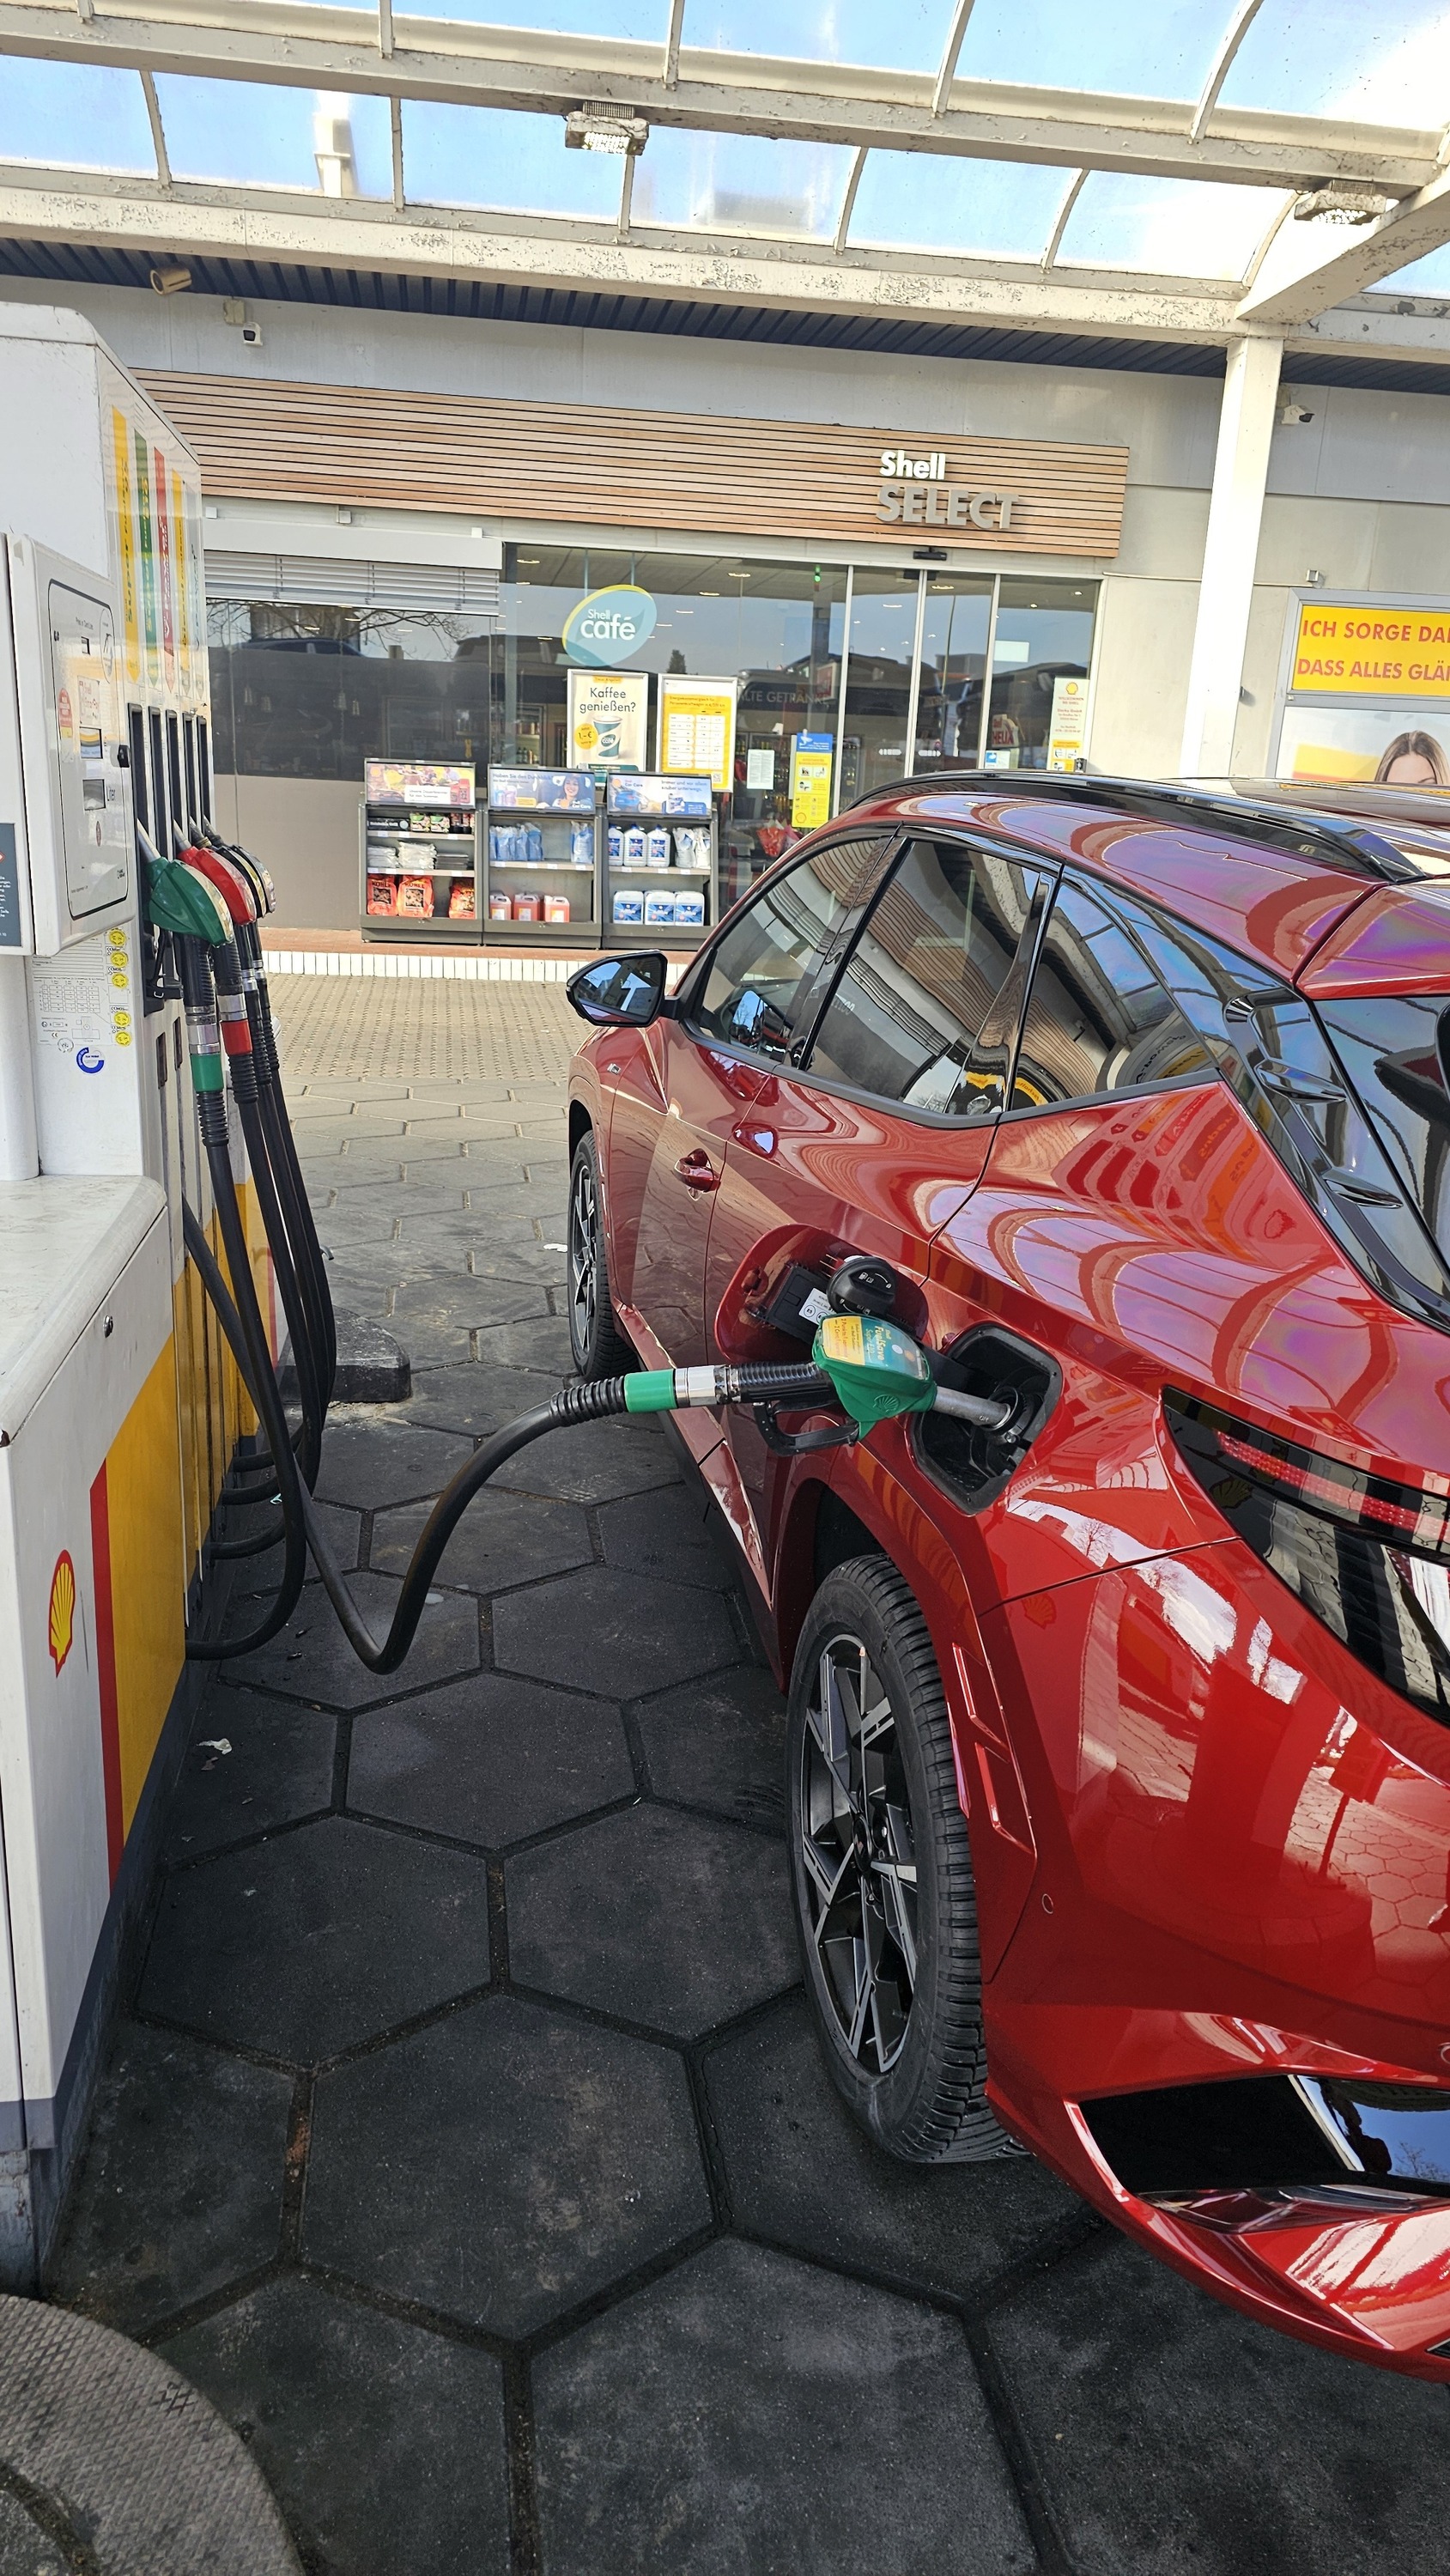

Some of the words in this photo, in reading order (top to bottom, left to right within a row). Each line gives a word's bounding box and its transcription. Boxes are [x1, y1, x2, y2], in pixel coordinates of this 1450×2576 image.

[879, 450, 946, 480] Shell
[876, 484, 1019, 530] SELECT
[587, 608, 610, 619] Shell
[580, 613, 636, 641] café
[1302, 620, 1337, 637] ICH
[1344, 623, 1411, 641] SORGE
[1297, 659, 1344, 677] DASS
[1350, 661, 1403, 679] ALLES
[590, 687, 627, 699] Kaffee
[579, 701, 636, 714] genießen?
[874, 1325, 885, 1361] FuelSave
